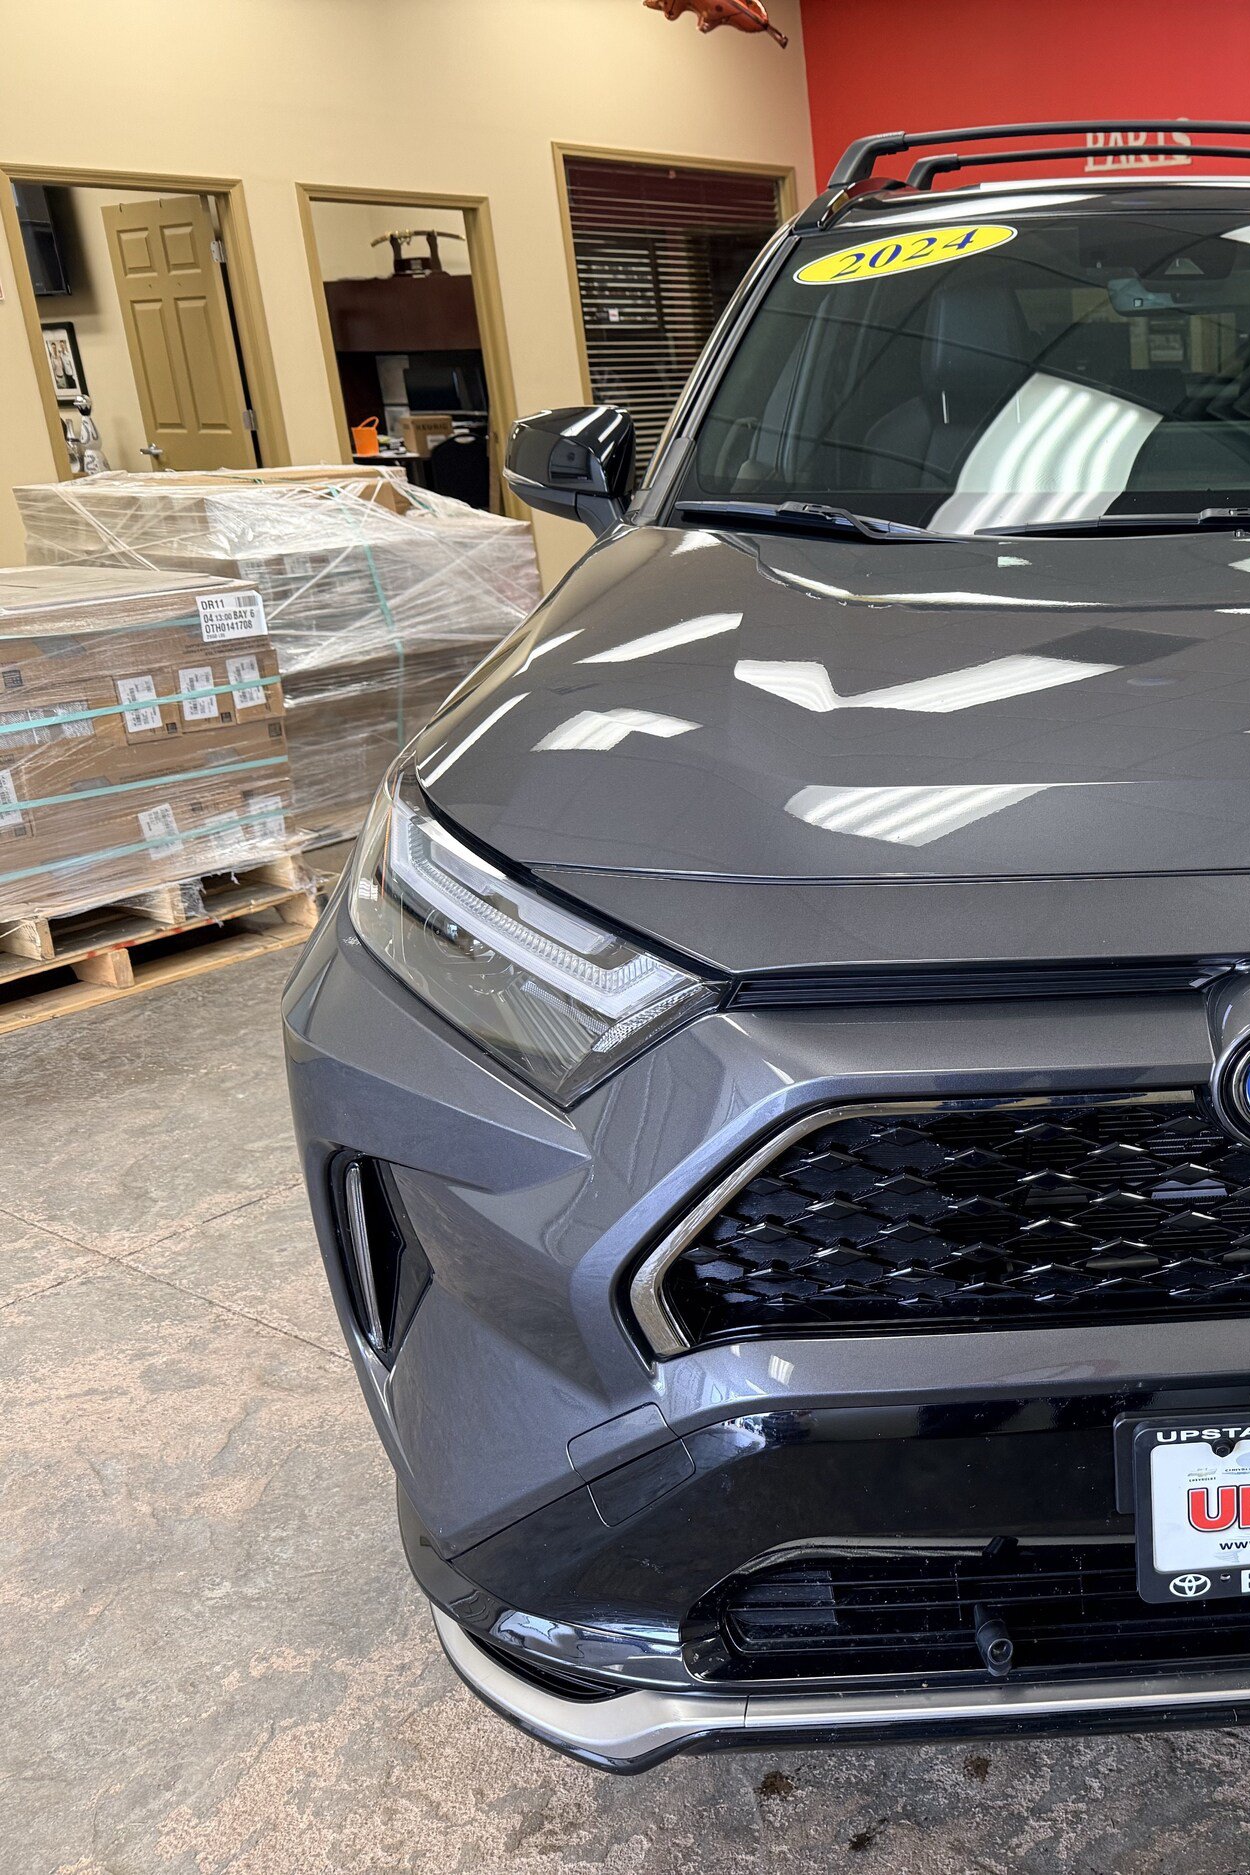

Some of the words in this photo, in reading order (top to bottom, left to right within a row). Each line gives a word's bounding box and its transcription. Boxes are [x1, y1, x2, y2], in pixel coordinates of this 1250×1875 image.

[830, 228, 979, 279] 2024
[200, 598, 225, 611] DR11
[203, 613, 214, 624] 04
[233, 609, 248, 620] BAY
